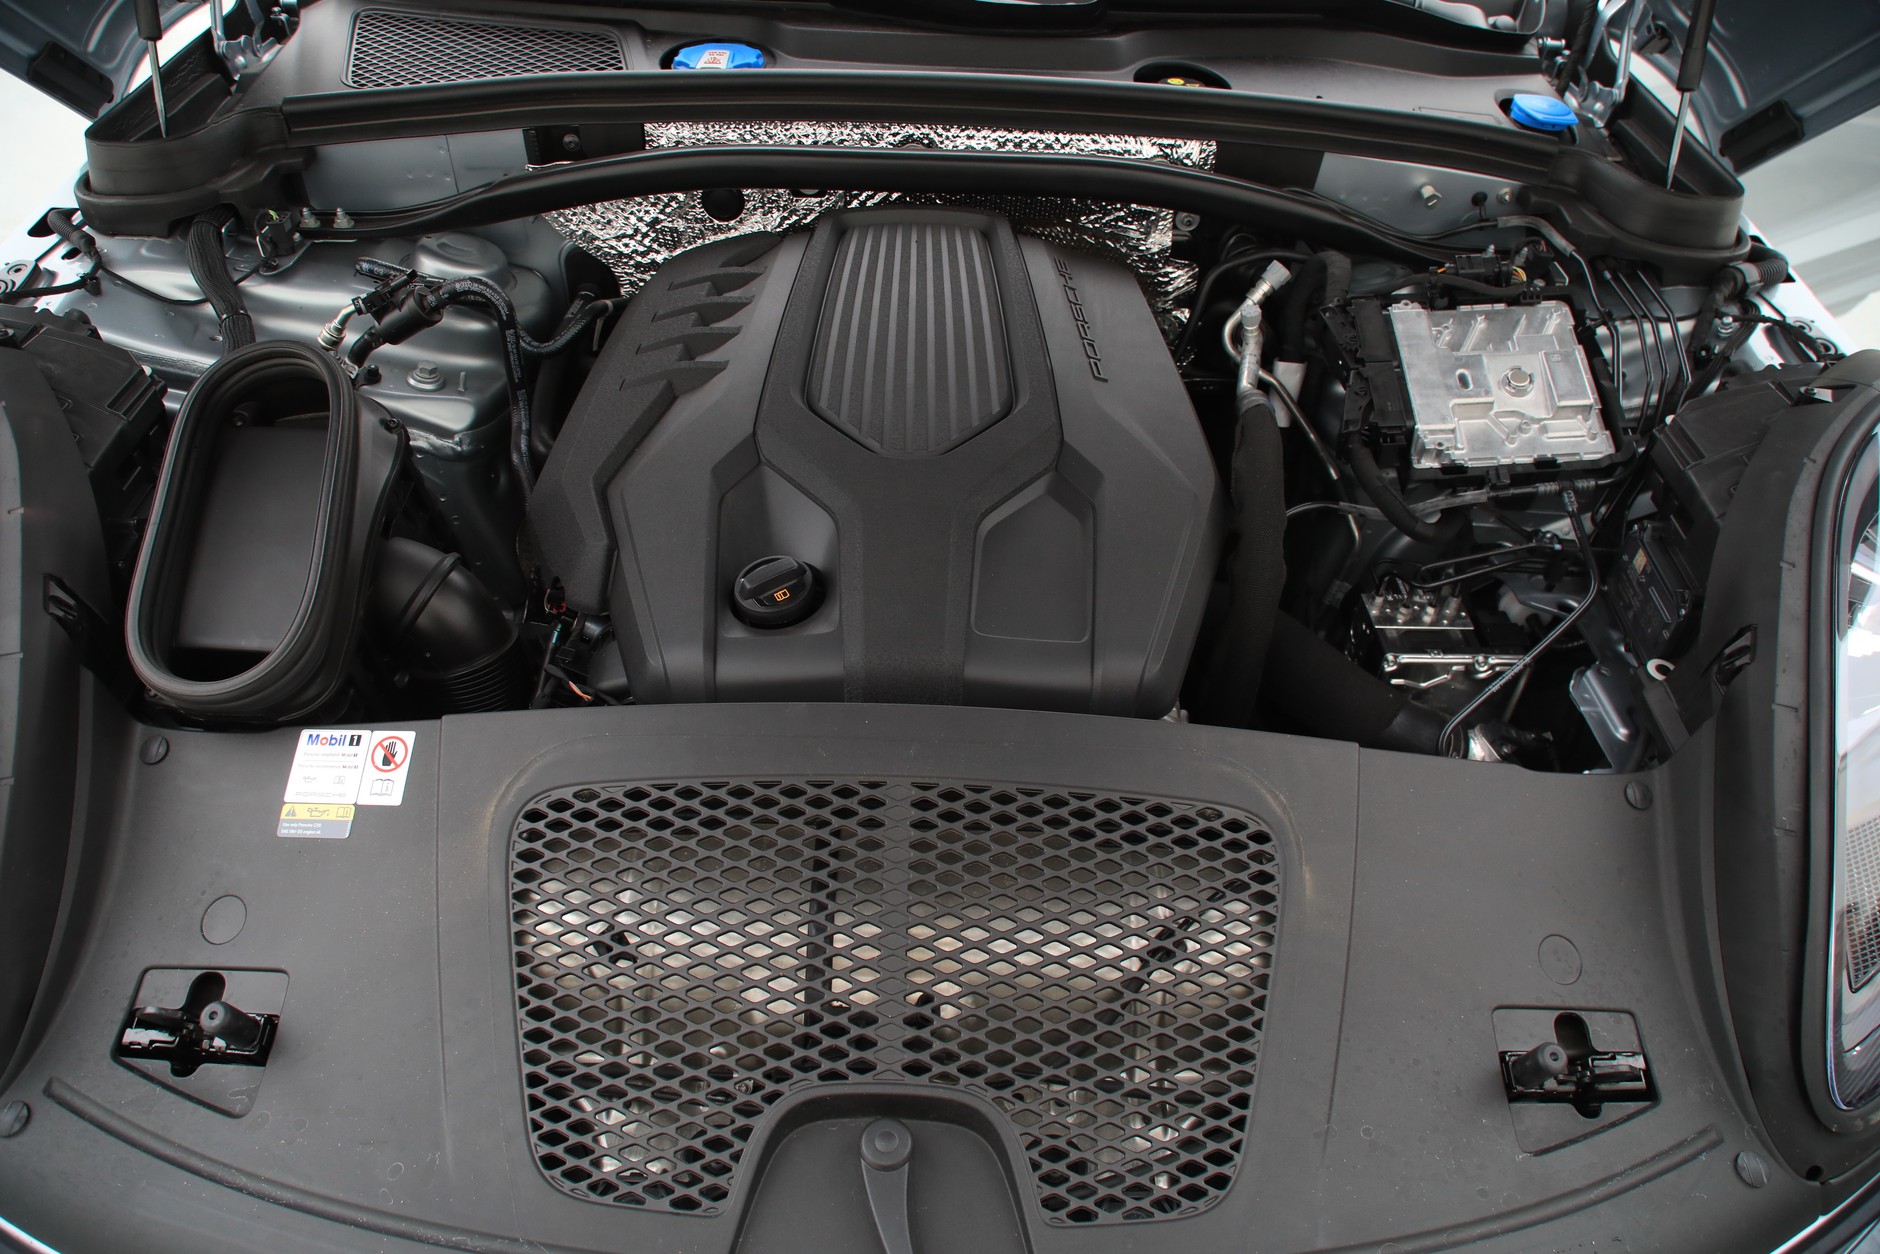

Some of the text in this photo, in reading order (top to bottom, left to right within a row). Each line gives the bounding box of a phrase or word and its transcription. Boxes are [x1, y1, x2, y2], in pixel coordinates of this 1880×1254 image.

[1054, 257, 1108, 383] PORSCHE
[306, 733, 362, 747] Mobil 1
